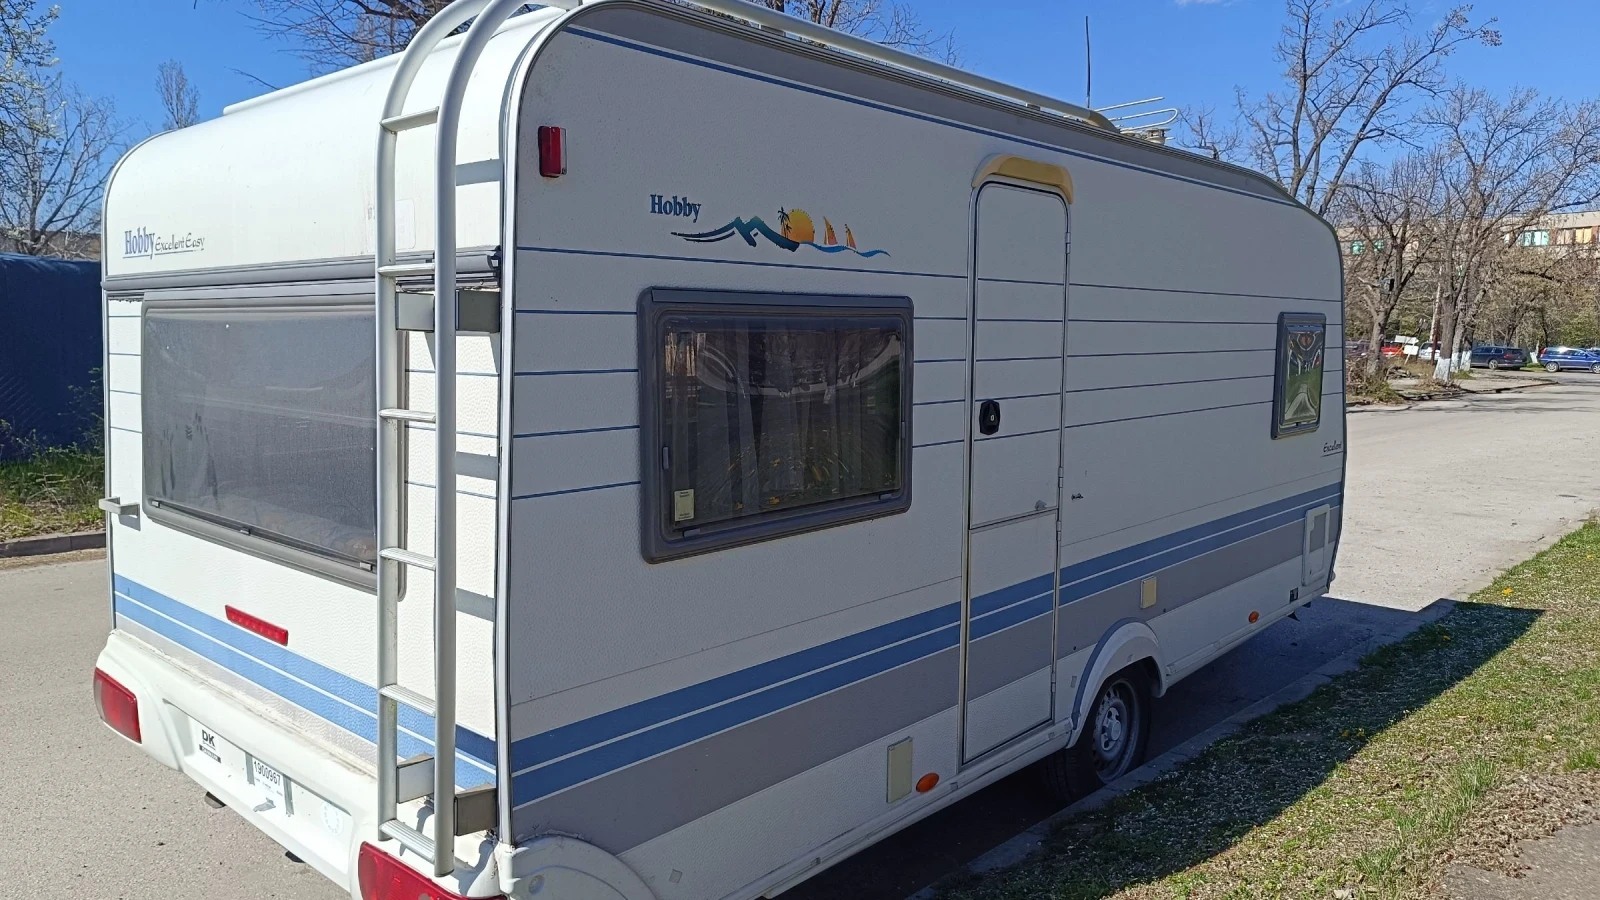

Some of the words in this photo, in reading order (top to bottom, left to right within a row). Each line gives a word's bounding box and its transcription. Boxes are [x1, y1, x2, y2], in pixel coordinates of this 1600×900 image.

[650, 194, 702, 223] Hobby
[124, 226, 155, 260] Hobby
[202, 729, 216, 748] DK
[254, 760, 281, 786] 1900967
